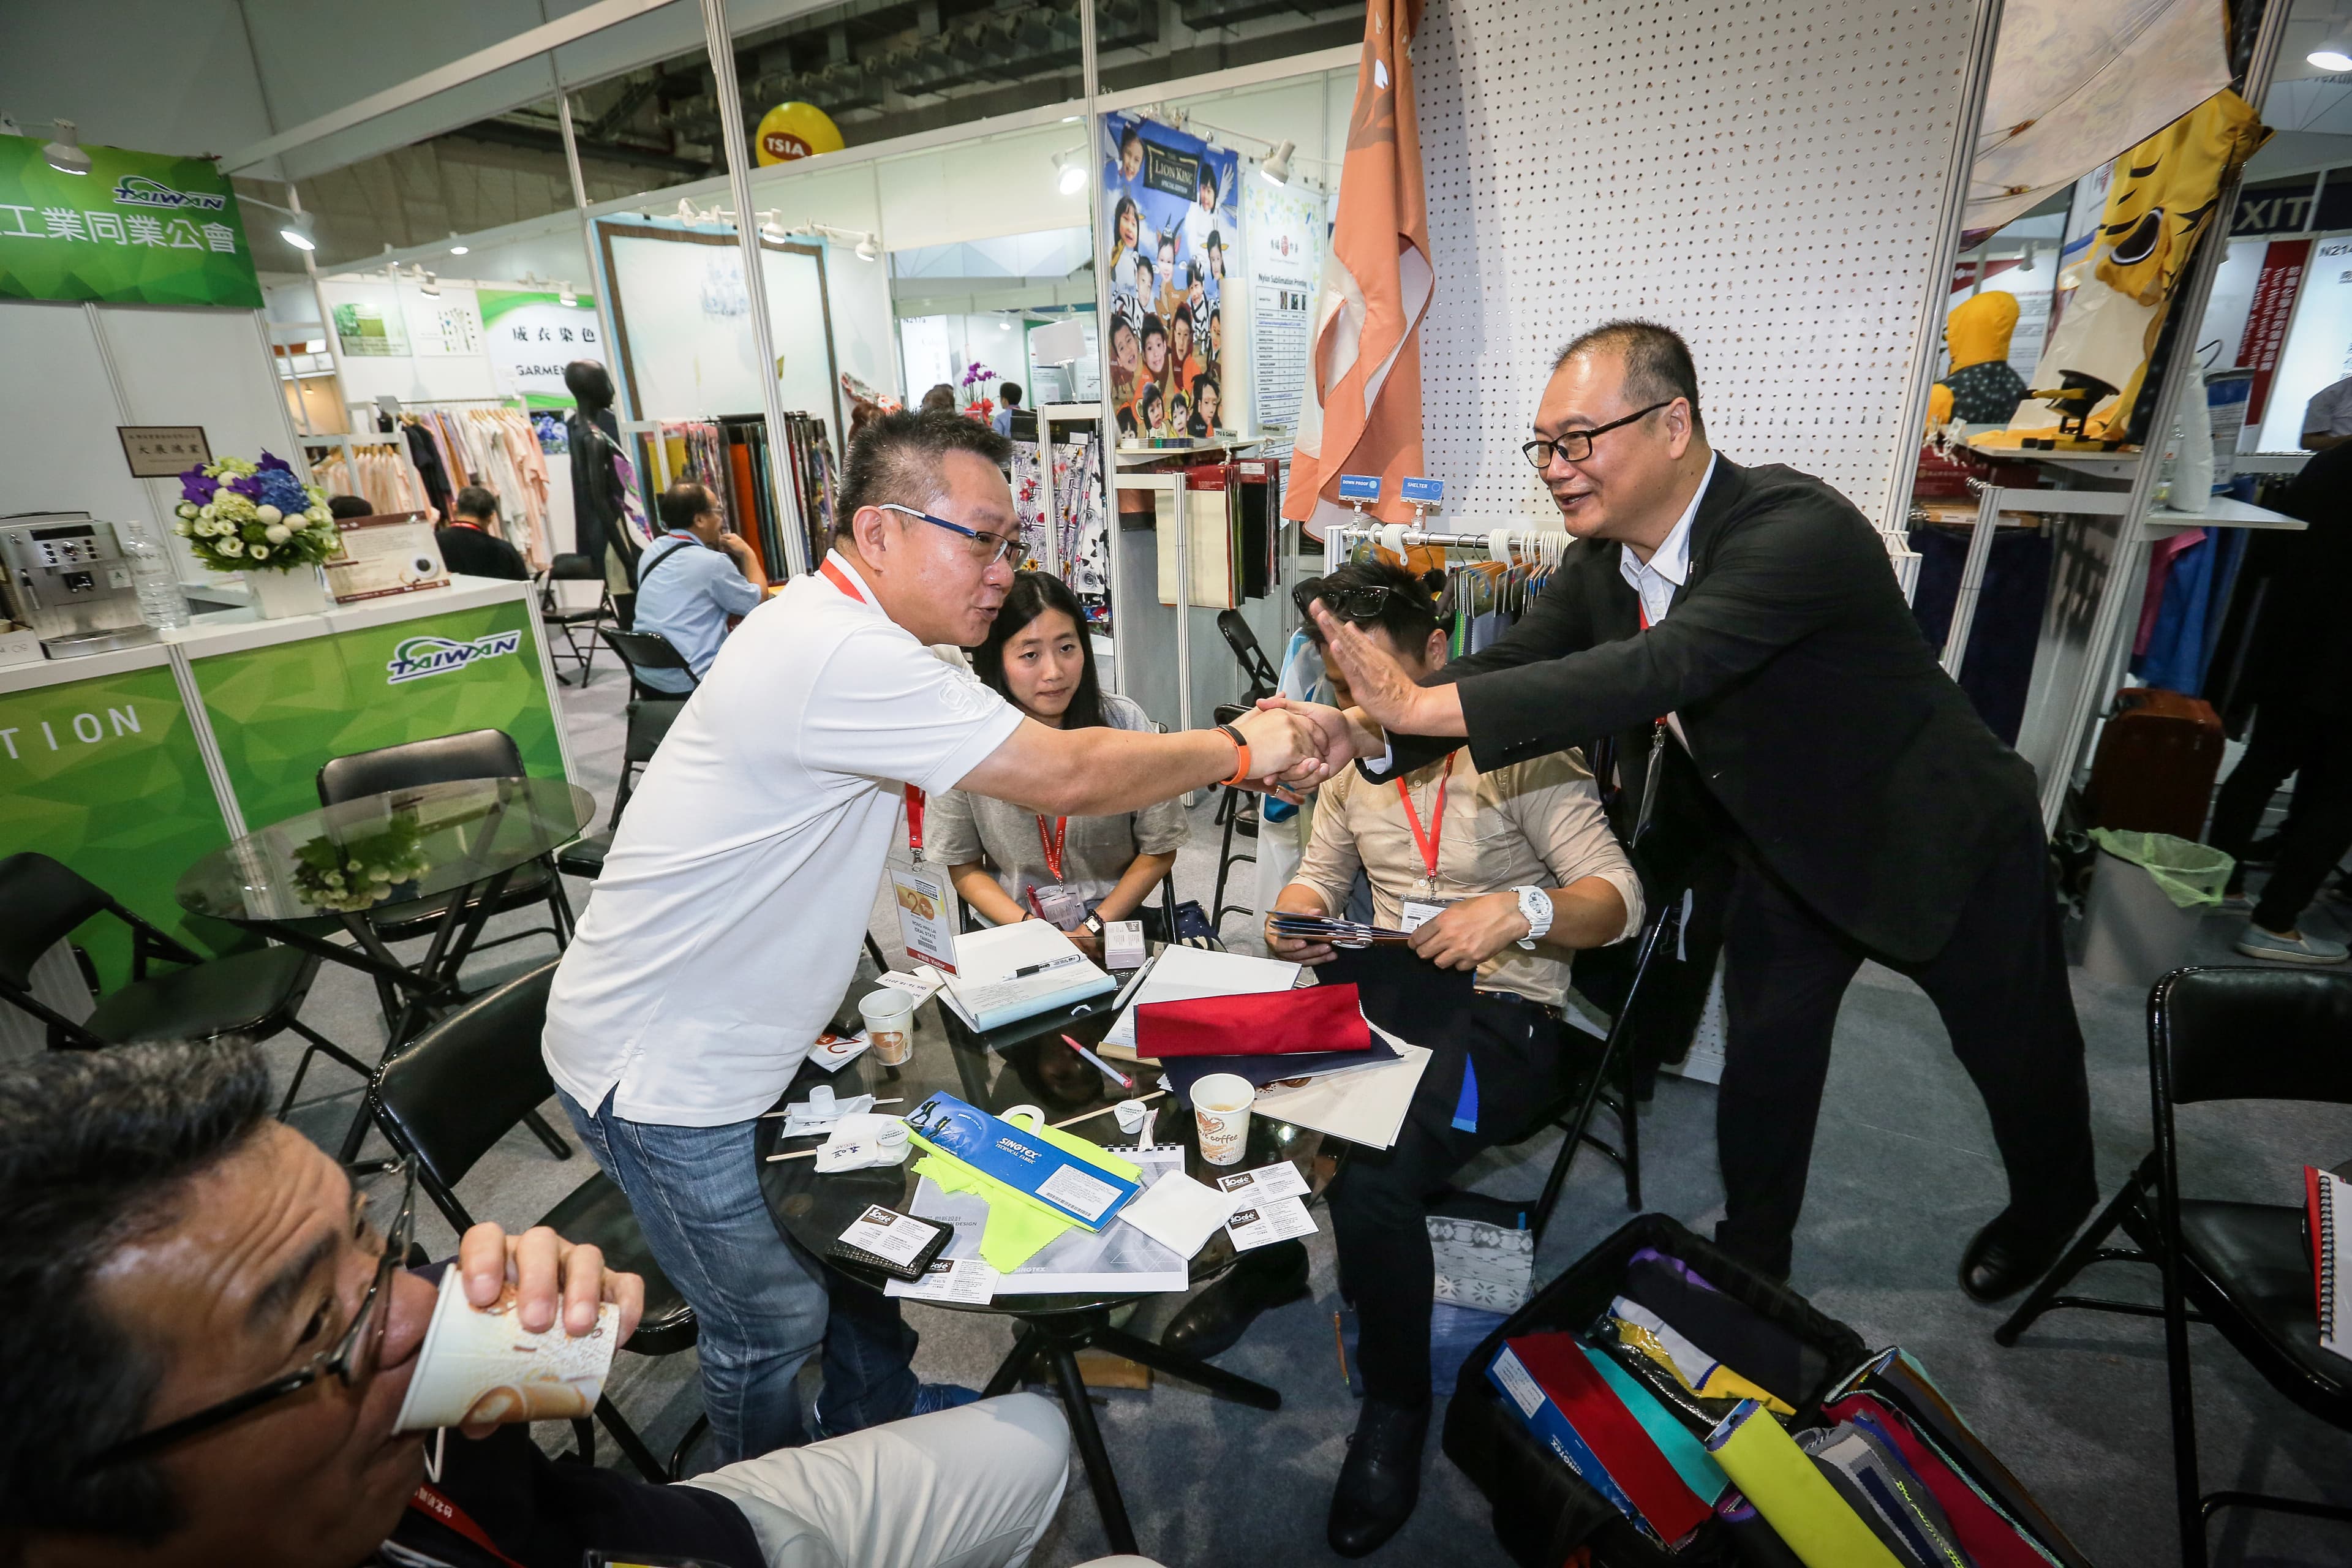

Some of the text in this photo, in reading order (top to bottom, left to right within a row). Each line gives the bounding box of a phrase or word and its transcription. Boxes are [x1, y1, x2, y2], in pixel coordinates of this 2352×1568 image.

[766, 137, 805, 156] TSIA
[1155, 159, 1193, 185] LION KING
[114, 187, 225, 209] TAIWAN
[2231, 196, 2313, 231] XIT
[0, 204, 236, 254] 工業同業公會
[512, 326, 595, 342] 成衣染色
[389, 637, 519, 677] TAIWAN
[930, 959, 945, 970] Visitor
[999, 1137, 1039, 1159] SINGTEX
[1210, 1134, 1238, 1144] coffee
[995, 1143, 1036, 1164] TECHNICAL FABRIC
